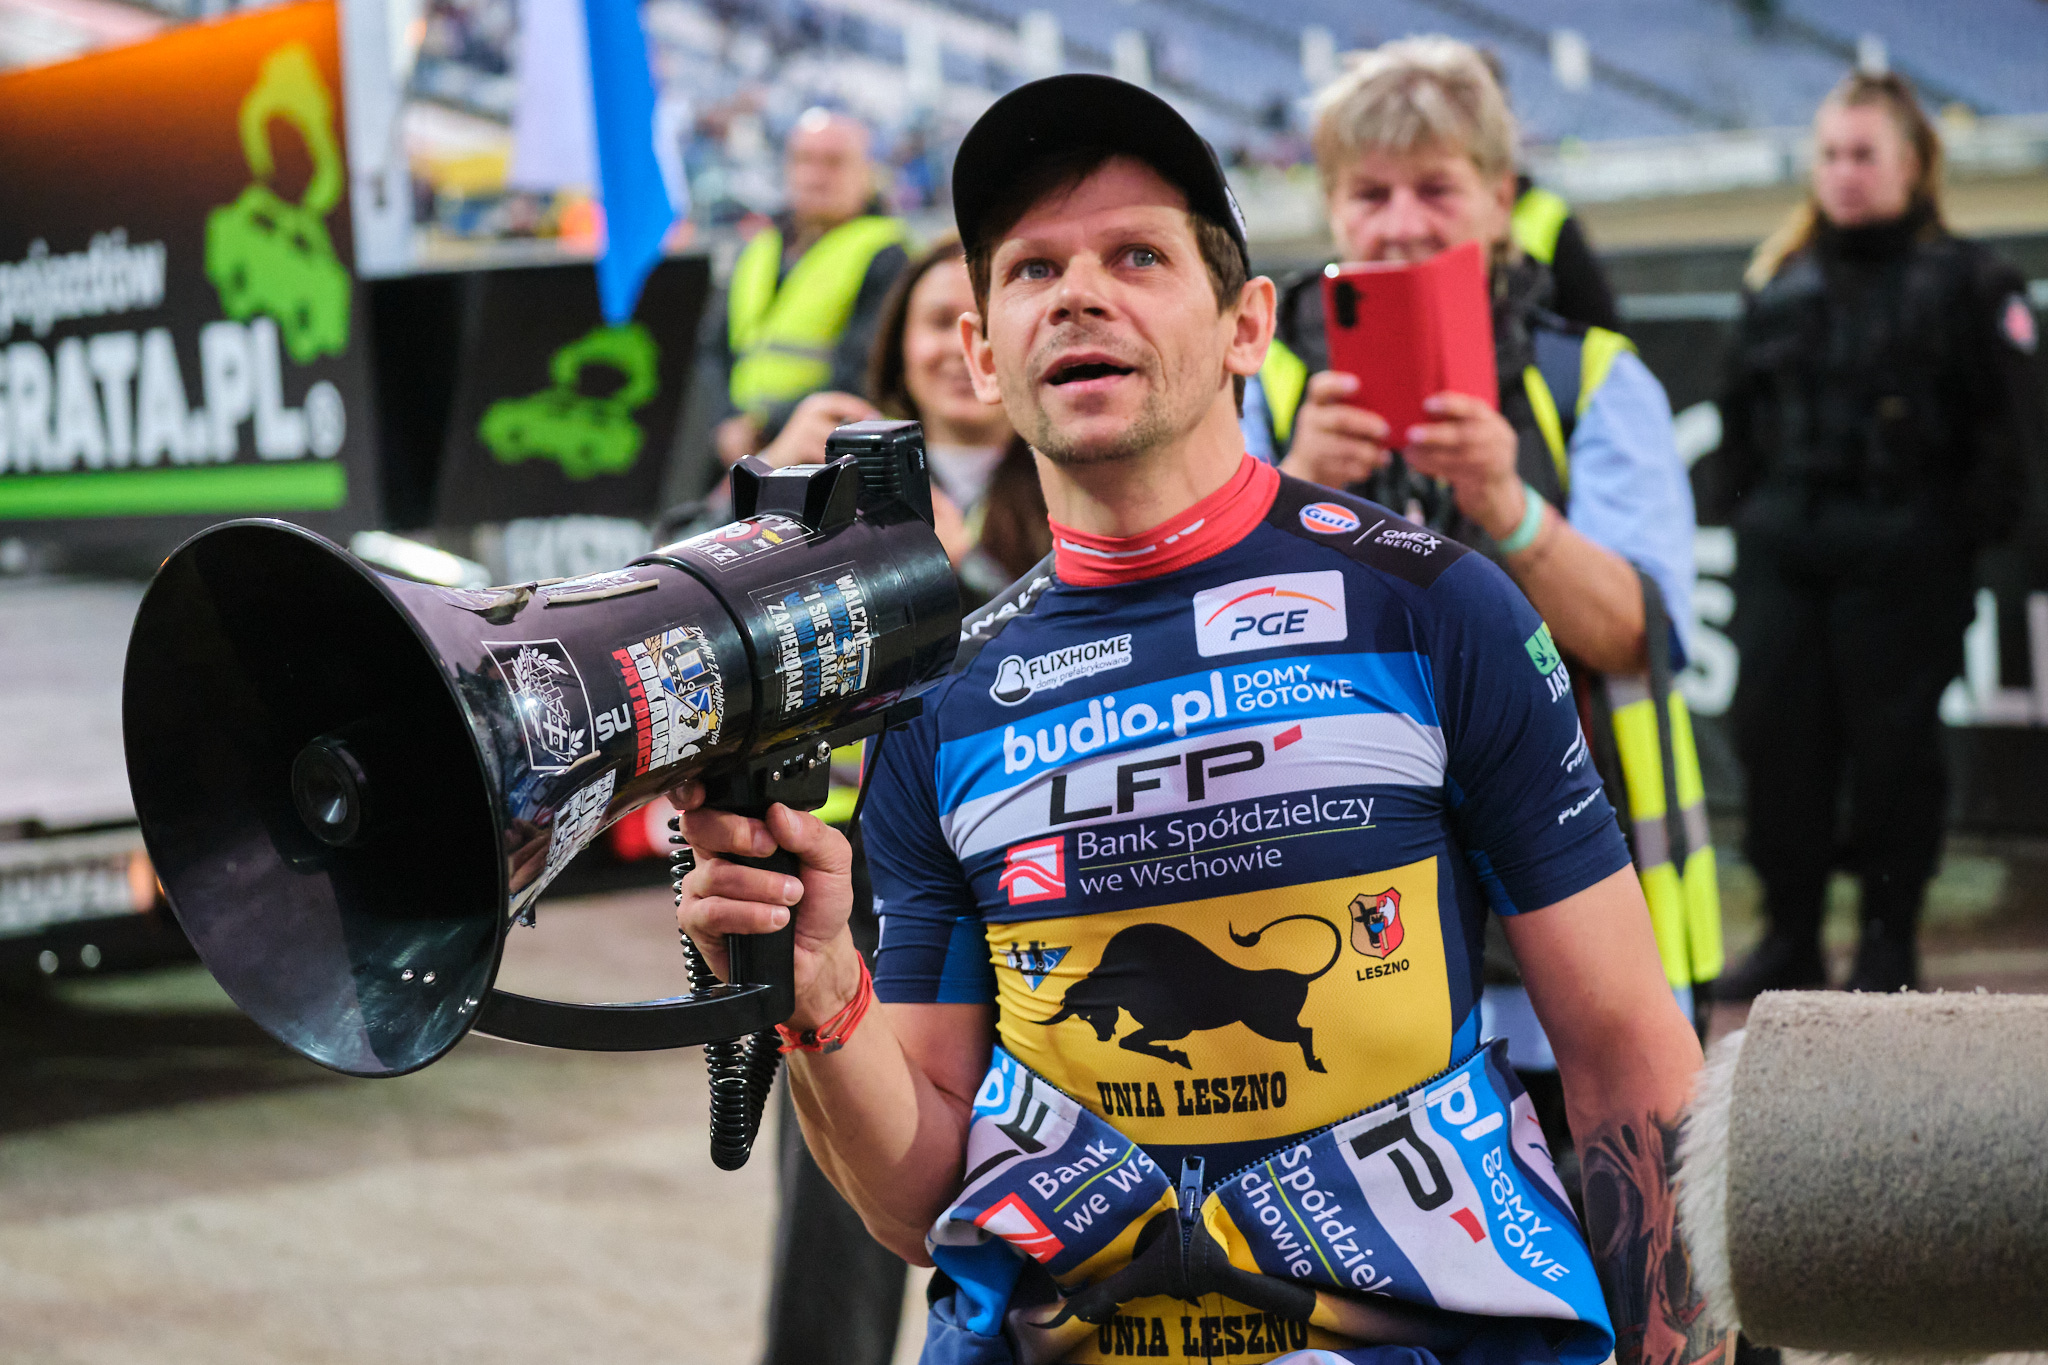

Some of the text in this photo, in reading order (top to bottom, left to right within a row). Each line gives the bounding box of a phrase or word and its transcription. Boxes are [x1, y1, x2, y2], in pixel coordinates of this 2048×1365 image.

[1305, 508, 1354, 529] Gulf
[1374, 536, 1433, 557] ENERGY
[803, 592, 822, 603] I
[1230, 609, 1309, 641] PGE
[1028, 636, 1129, 680] FLIXHOME
[1036, 654, 1130, 690] domy prefabrykowane
[1233, 664, 1312, 693] DOMY
[611, 647, 652, 778] PATRIOCI
[626, 641, 670, 772] LOKALNI
[1236, 679, 1355, 713] GOTOWE
[595, 702, 632, 742] SU
[1003, 670, 1229, 775] budio.pl
[1050, 740, 1265, 826] LFP
[1077, 794, 1375, 860] Bank Spółdzielczy
[1079, 844, 1283, 896] we Wschowie
[1356, 958, 1410, 982] LESZNO
[1096, 1071, 1287, 1118] UNIA LESZNO
[1028, 1139, 1118, 1201] Bank
[1493, 1145, 1553, 1238] DOMY
[1063, 1193, 1111, 1235] we
[1481, 1152, 1571, 1283] GOTOWE
[1098, 1312, 1309, 1359] UNIA LESZNO
